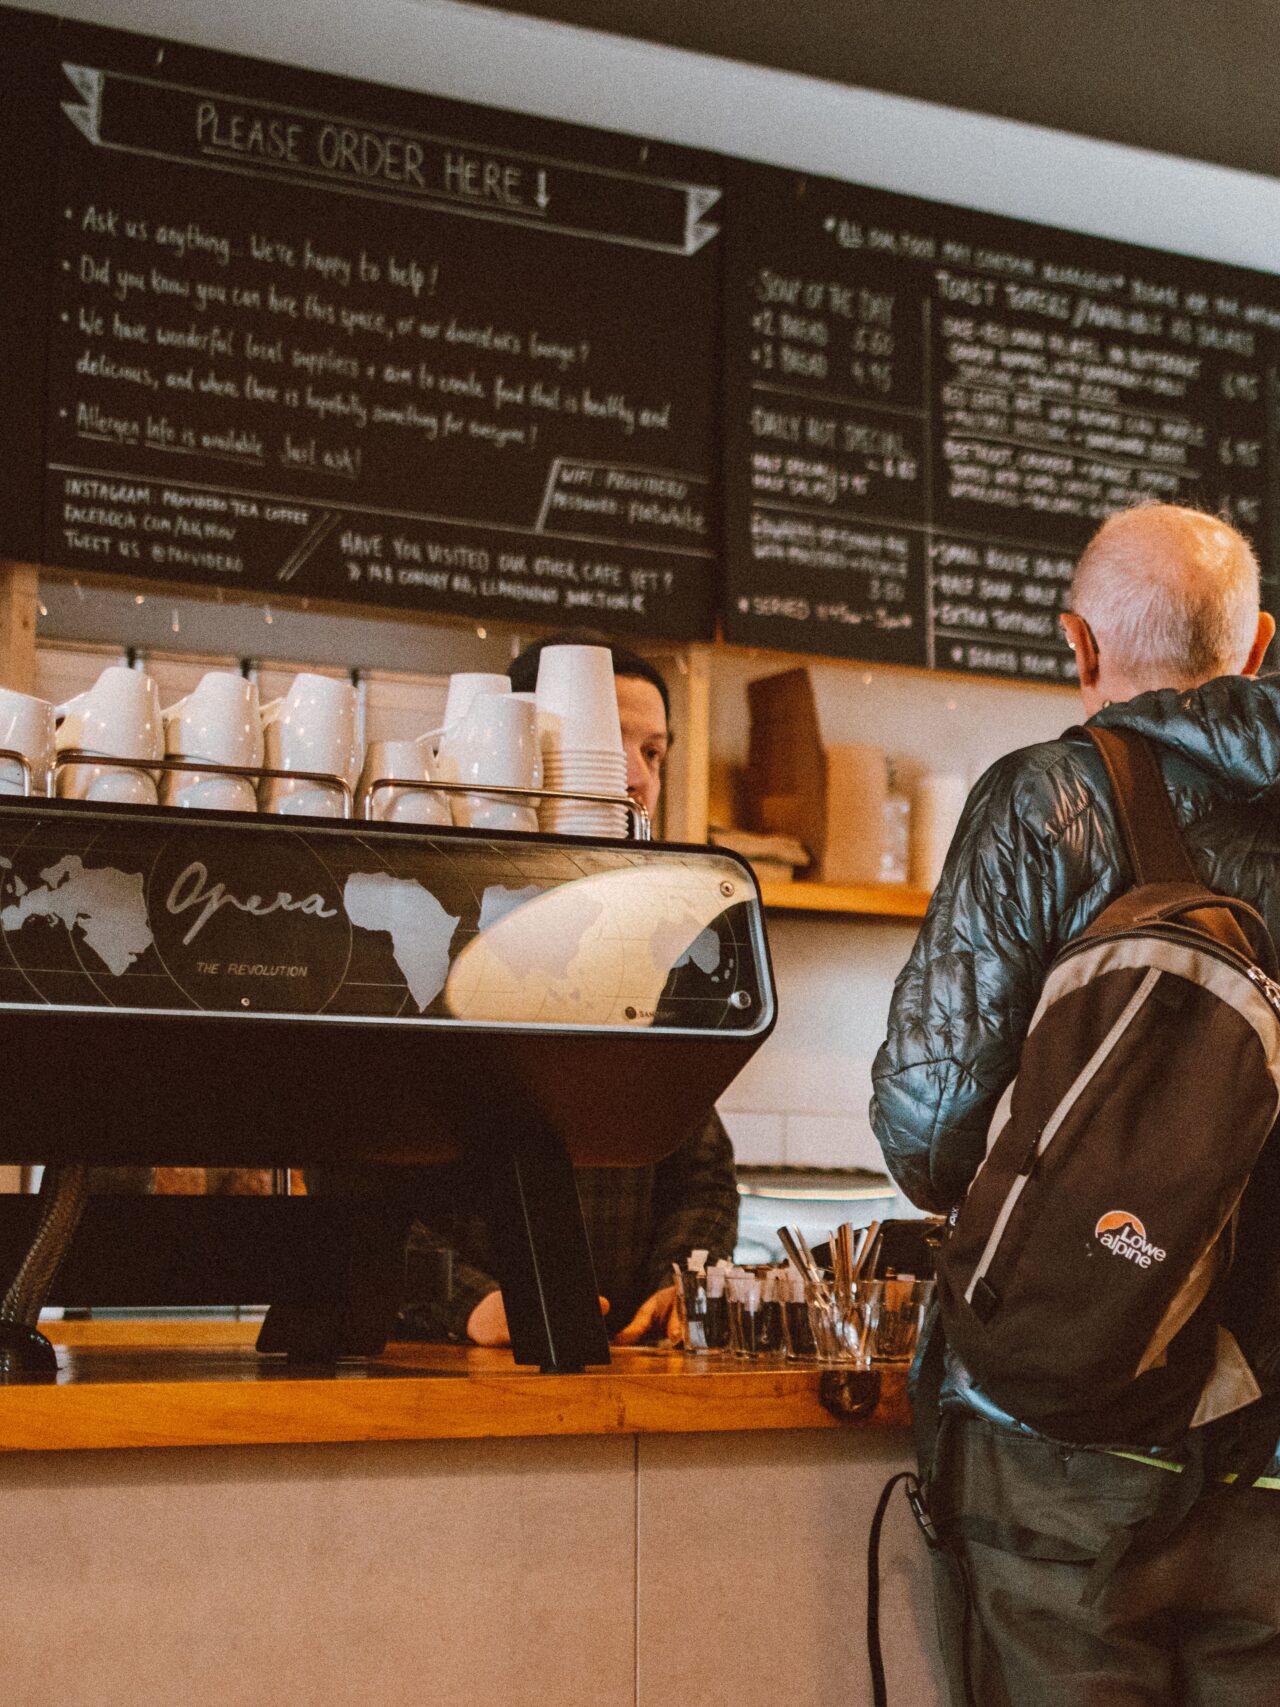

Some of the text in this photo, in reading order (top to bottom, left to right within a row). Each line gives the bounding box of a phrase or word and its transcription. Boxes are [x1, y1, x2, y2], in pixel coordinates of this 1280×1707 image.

[197, 102, 523, 206] PLEASE ORDER HERE
[82, 205, 118, 237] Ask
[126, 220, 147, 241] us
[304, 240, 352, 286] happy
[360, 251, 381, 282] to
[80, 254, 110, 285] Did
[117, 272, 146, 301] you
[152, 267, 190, 297] know
[196, 283, 227, 312] you
[232, 288, 261, 308] can
[304, 294, 336, 325] this
[935, 269, 996, 307] TOAST
[80, 307, 105, 336] We
[113, 313, 150, 343] have
[156, 323, 234, 358] wonderful
[246, 333, 284, 362] local
[494, 376, 525, 410] food
[530, 382, 560, 408] that
[564, 394, 579, 415] is
[640, 402, 672, 431] and
[165, 368, 194, 393] and
[230, 497, 260, 518] TEA
[263, 506, 310, 526] COFFEE
[62, 528, 111, 554] TWEET
[117, 539, 141, 560] US
[339, 529, 384, 559] HAVE
[393, 536, 422, 561] YOU
[427, 543, 489, 573] VISITED
[165, 860, 340, 947] Opera
[196, 961, 308, 978] THE REVOLUTION
[1099, 1232, 1152, 1270] alpine
[1119, 1225, 1167, 1263] Lowe
